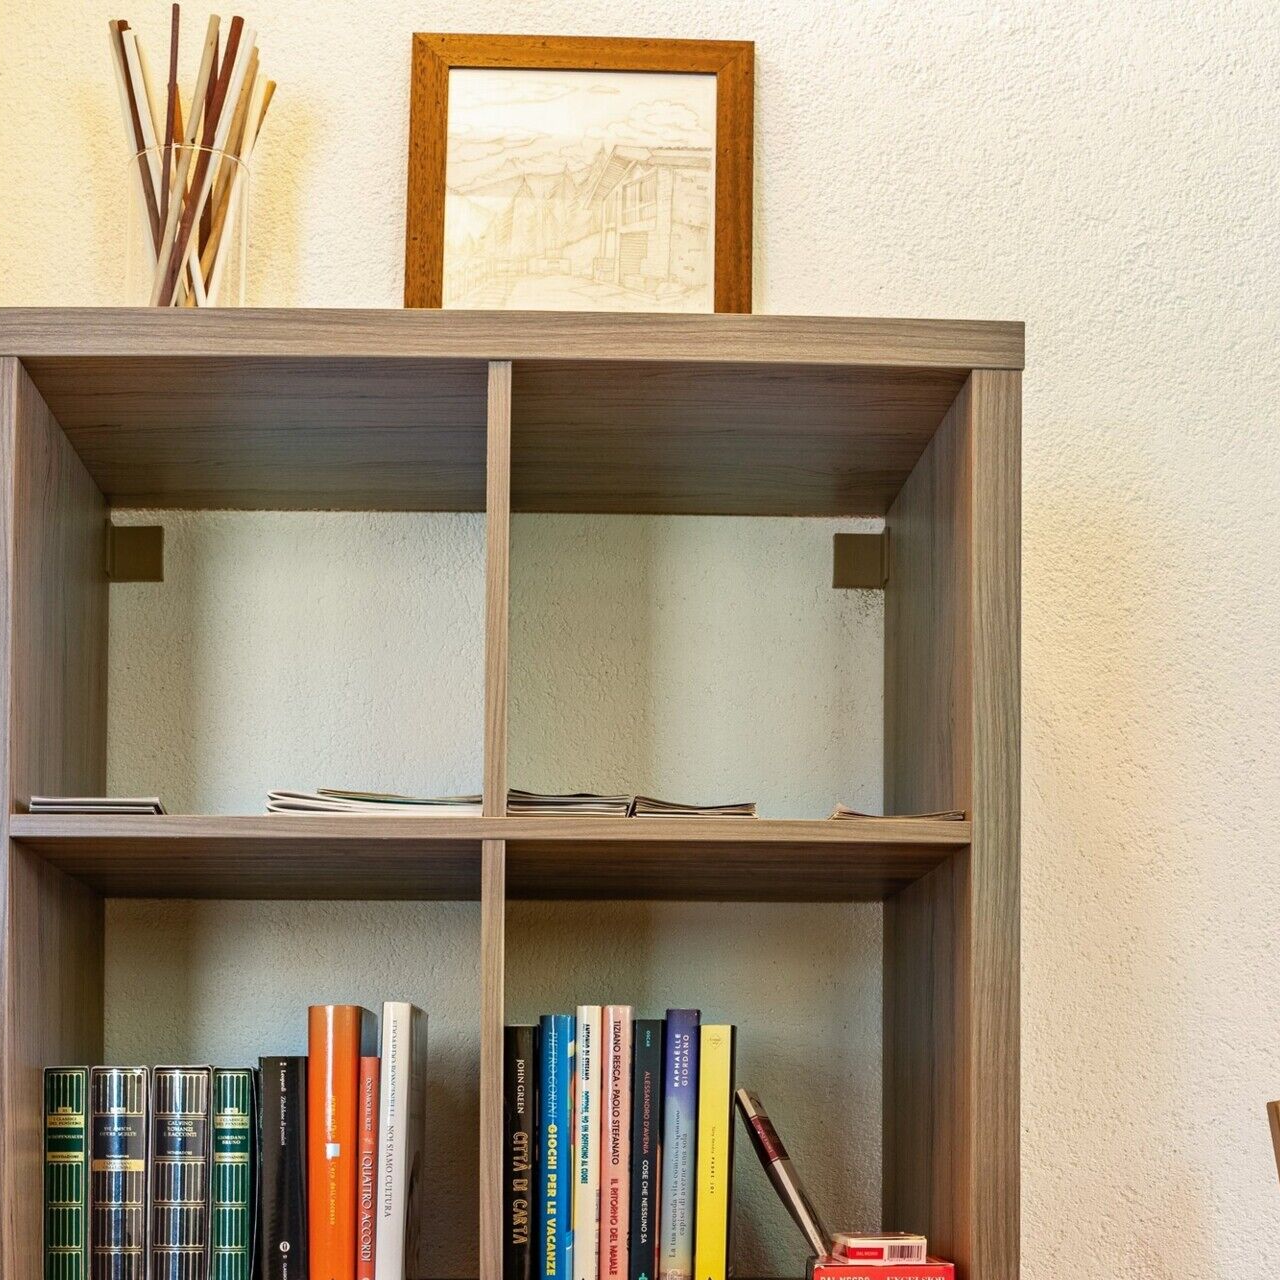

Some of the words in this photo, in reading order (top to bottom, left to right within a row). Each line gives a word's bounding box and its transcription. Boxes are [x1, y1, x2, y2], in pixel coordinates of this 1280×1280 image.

[613, 1020, 622, 1052] TIZIANO
[548, 1031, 558, 1072] PIETRO
[673, 1033, 681, 1088] RAPHAËLLE
[681, 1034, 690, 1087] GIORDANO
[516, 1059, 525, 1083] JOHN
[612, 1054, 621, 1082] RESCA
[517, 1085, 525, 1114] GREEN
[548, 1073, 558, 1118] GORINI
[612, 1088, 621, 1118] PAOLO
[643, 1071, 651, 1120] ALESSANDRO
[386, 1125, 395, 1142] NOI
[547, 1123, 558, 1170] GIOCHI
[581, 1133, 589, 1159] SOFFICINO
[611, 1119, 620, 1165] STEFANATO
[680, 1132, 688, 1150] sola
[385, 1144, 394, 1173] SIAMO
[513, 1131, 532, 1172] CITTÀ
[361, 1156, 373, 1210] QUATTRO
[513, 1178, 528, 1192] DI
[547, 1173, 557, 1197] PER
[580, 1167, 589, 1185] CUORE
[670, 1180, 679, 1197] vita
[384, 1175, 393, 1218] CULTURA
[547, 1200, 557, 1215] LE
[610, 1187, 619, 1226] RITORNO
[678, 1197, 686, 1206] di
[512, 1198, 528, 1244] CARTA
[641, 1197, 649, 1232] NESSUNO
[670, 1199, 678, 1231] seconda
[678, 1207, 686, 1236] capisci
[361, 1211, 372, 1262] ACCORDI
[546, 1217, 556, 1276] VACANZE
[610, 1228, 618, 1242] DEL
[641, 1233, 648, 1244] SA
[669, 1232, 677, 1246] tua
[609, 1245, 618, 1276] MAIALE
[669, 1248, 676, 1258] La
